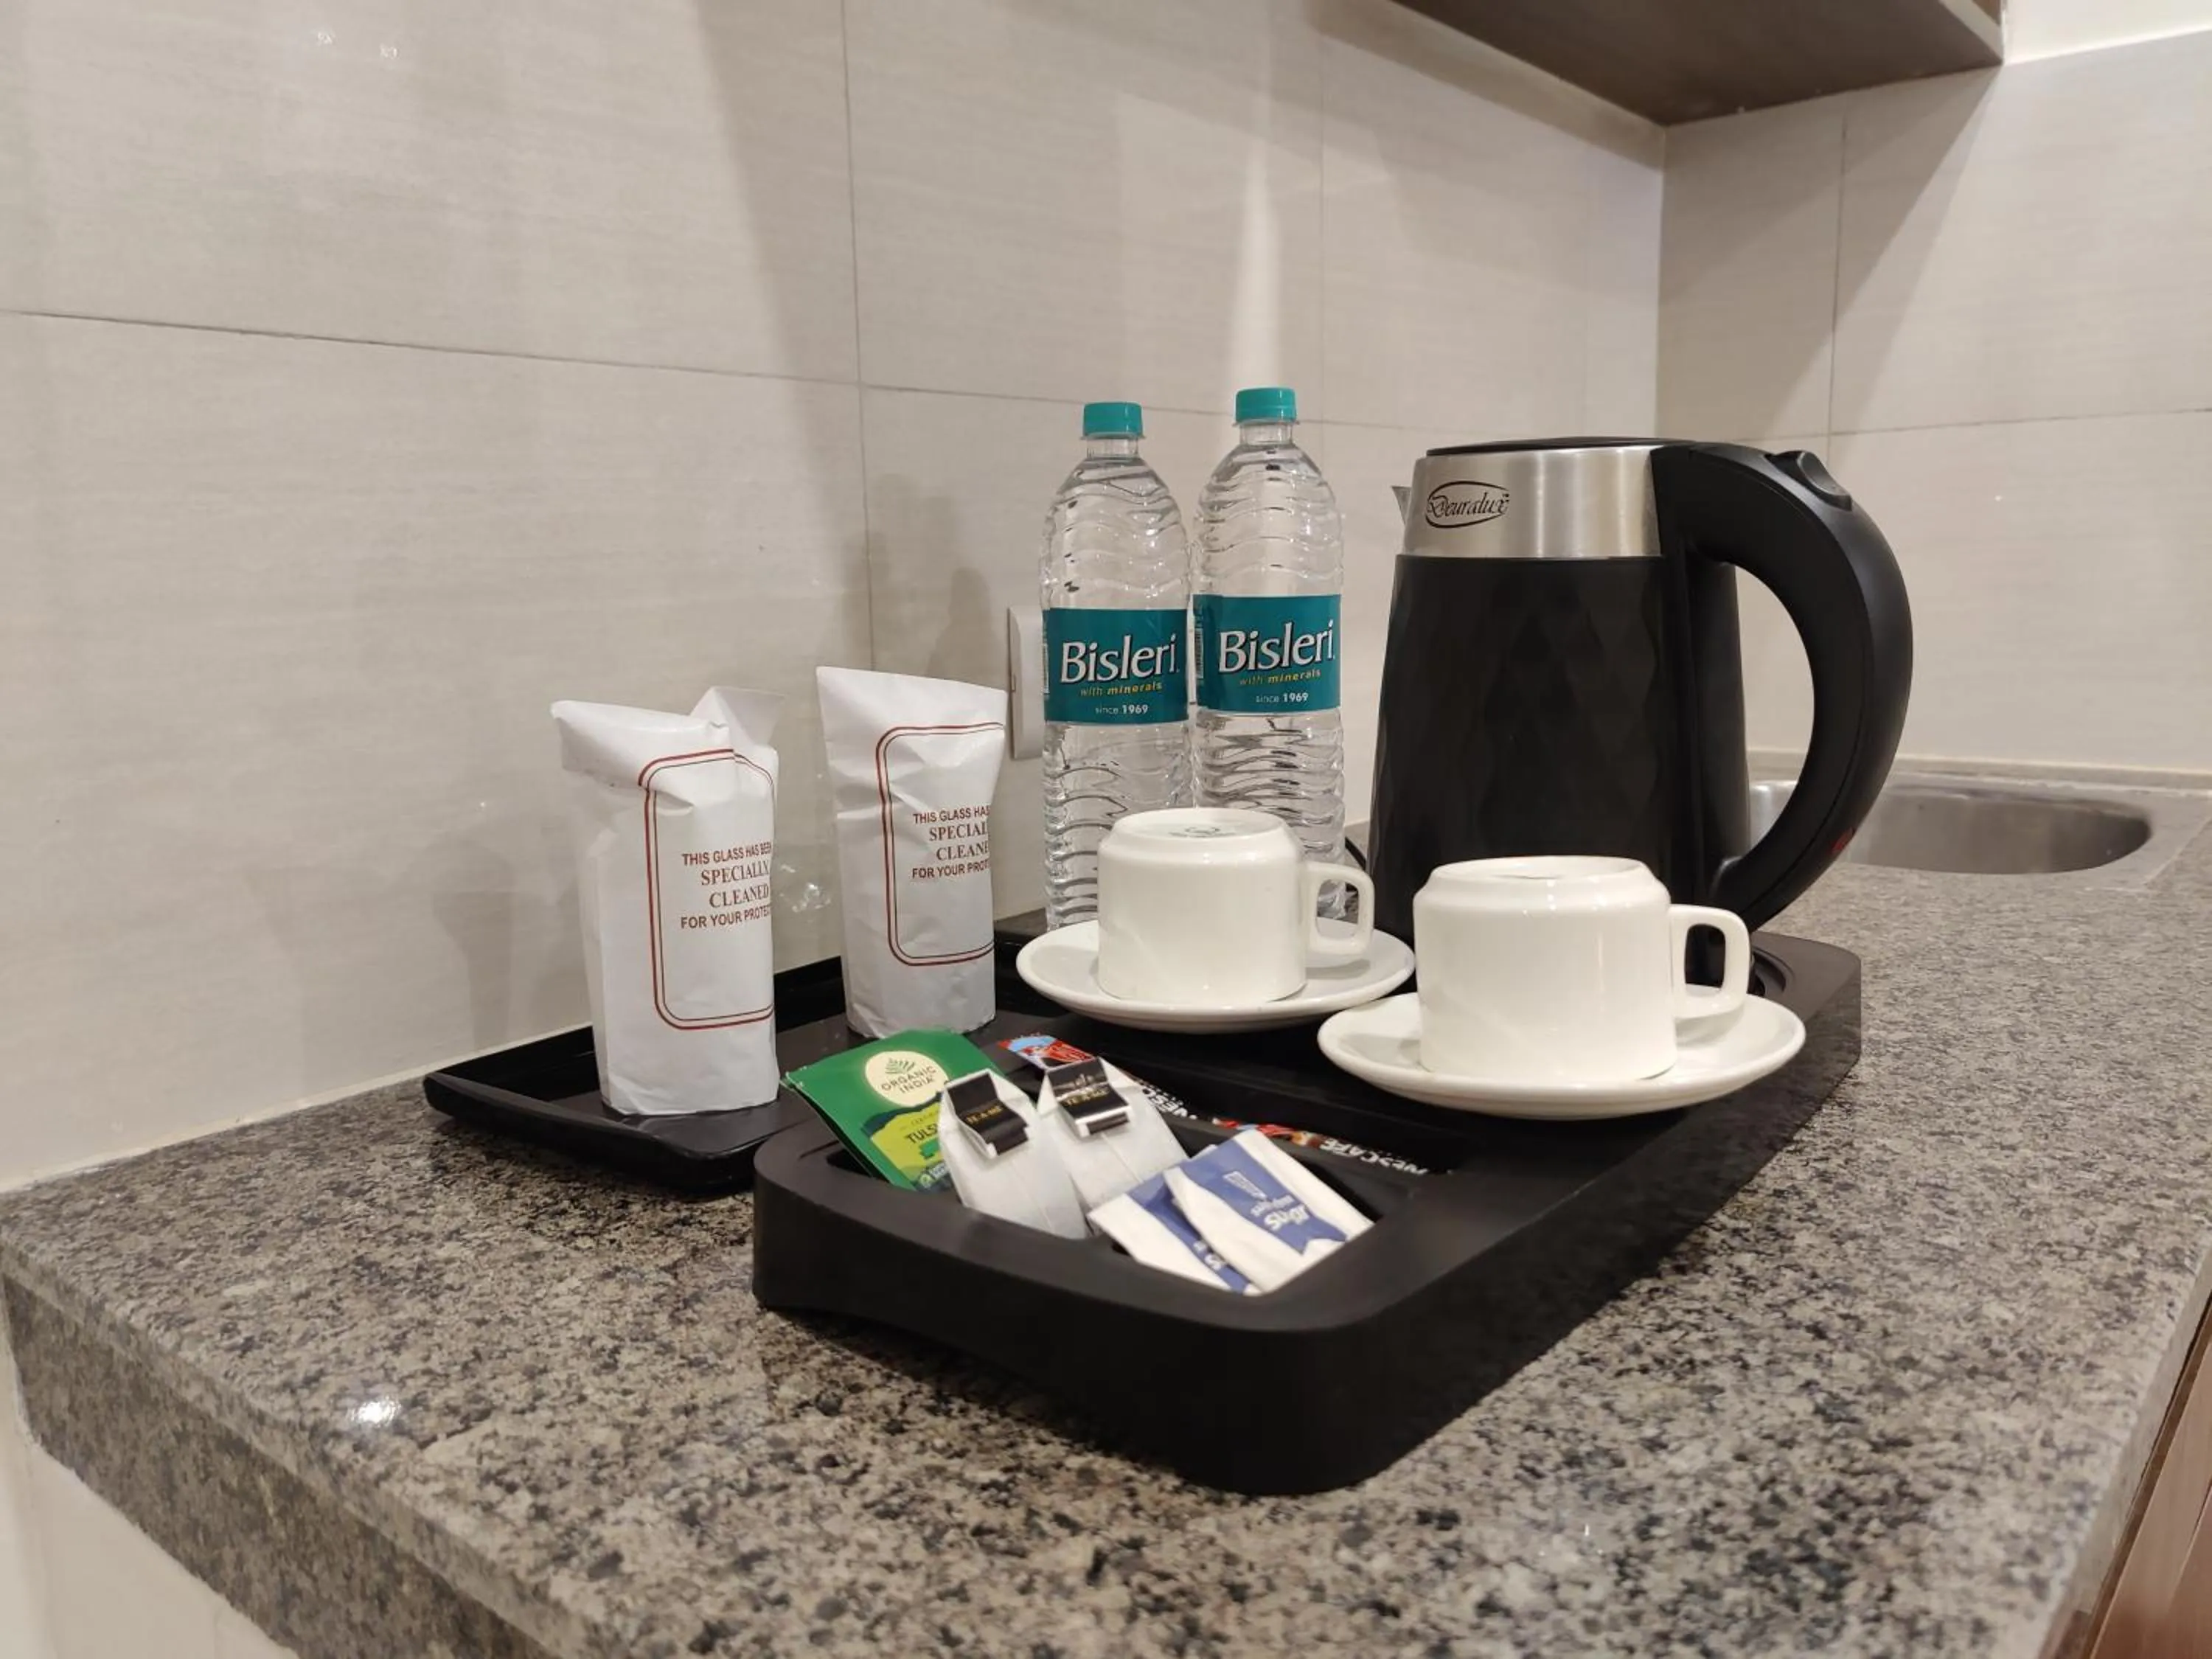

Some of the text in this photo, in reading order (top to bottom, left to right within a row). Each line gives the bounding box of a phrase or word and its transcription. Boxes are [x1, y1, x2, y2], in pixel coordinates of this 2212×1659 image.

[1219, 619, 1335, 674] Bisleri
[1060, 633, 1177, 684] Bisleri
[1239, 669, 1321, 685] with minerals
[1080, 681, 1163, 697] with minerals
[1256, 692, 1309, 703] since 1969
[1095, 704, 1148, 714] since 1969
[913, 812, 937, 824] THIS
[939, 807, 971, 821] GLASS
[929, 821, 987, 841] SPECIAL
[681, 850, 709, 866] THIS
[713, 847, 744, 863] GLASS
[745, 844, 759, 858] HAS
[912, 867, 935, 879] FOR
[937, 863, 965, 877] YOUR
[709, 883, 769, 908] CLEANED
[681, 915, 707, 929] FOR
[710, 911, 742, 926] YOUR
[880, 1065, 937, 1091] ORGANIC
[899, 1075, 935, 1095] INDIA
